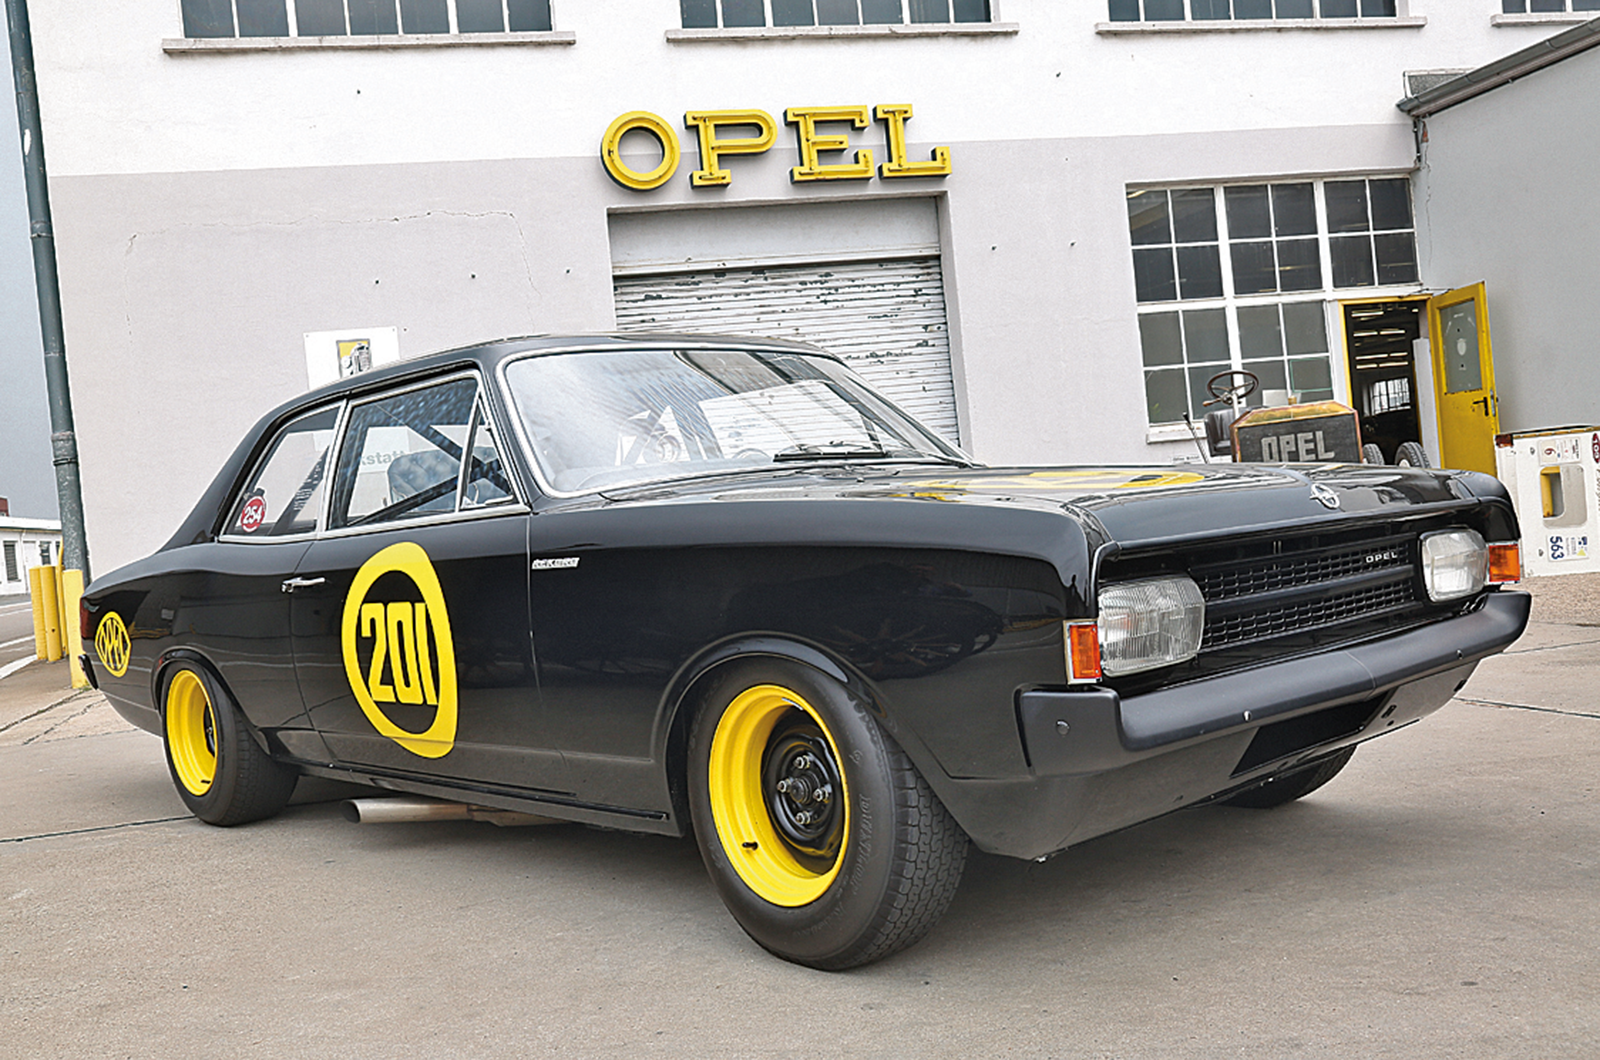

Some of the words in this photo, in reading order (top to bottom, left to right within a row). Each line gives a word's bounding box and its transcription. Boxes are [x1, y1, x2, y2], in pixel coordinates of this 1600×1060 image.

[601, 104, 951, 191] OPEL
[1261, 431, 1335, 463] OPEL
[242, 505, 263, 524] 254
[1365, 551, 1398, 563] OPEL
[1550, 536, 1565, 560] 563
[361, 602, 439, 705] 201
